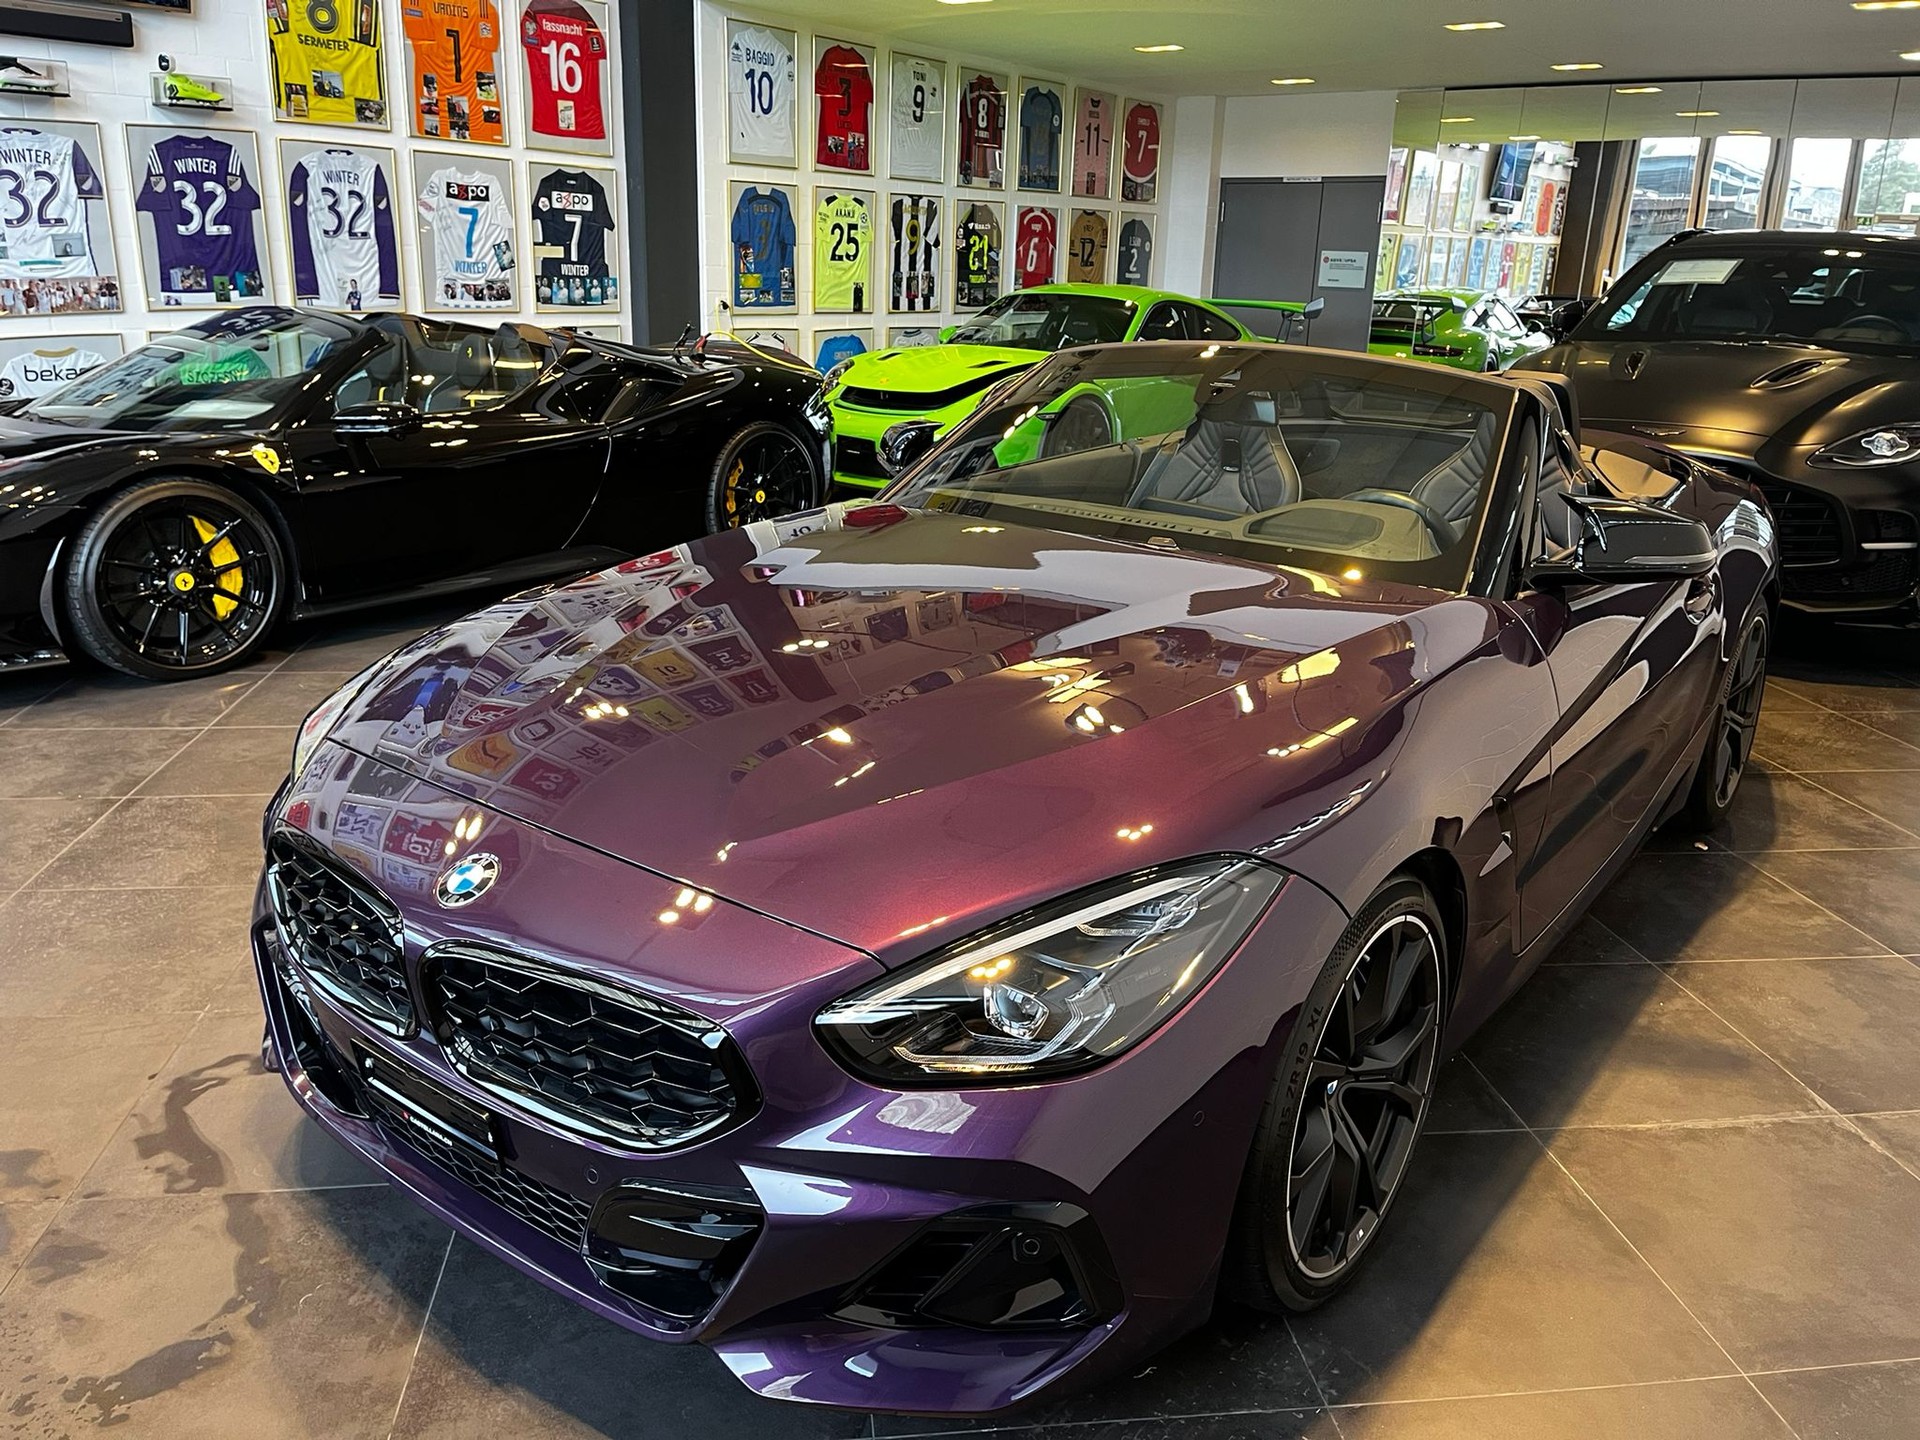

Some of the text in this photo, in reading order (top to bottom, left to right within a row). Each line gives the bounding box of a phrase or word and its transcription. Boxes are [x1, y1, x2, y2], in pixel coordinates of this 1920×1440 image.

[297, 33, 351, 52] SERMETER
[542, 19, 583, 36] fassnacht
[446, 28, 462, 83] 1
[541, 40, 583, 94] 16
[745, 47, 775, 67] BAGGIO
[744, 68, 774, 115] 10
[912, 84, 925, 123] 9
[977, 97, 989, 129] 8
[0, 147, 51, 165] WINTER
[1138, 129, 1148, 163] 7
[173, 157, 217, 175] WINTER
[322, 169, 360, 186] WINTER
[0, 168, 68, 228] 32
[172, 180, 232, 236] 32
[321, 186, 371, 240] 32
[457, 206, 479, 258] 7
[564, 213, 582, 262] 7
[830, 222, 860, 262] 25
[455, 260, 488, 274] WINTER
[561, 263, 589, 277] WINTER
[1026, 237, 1040, 272] 6
[1129, 247, 1138, 272] 2
[24, 364, 87, 382] beka
[1307, 1005, 1325, 1031] XL
